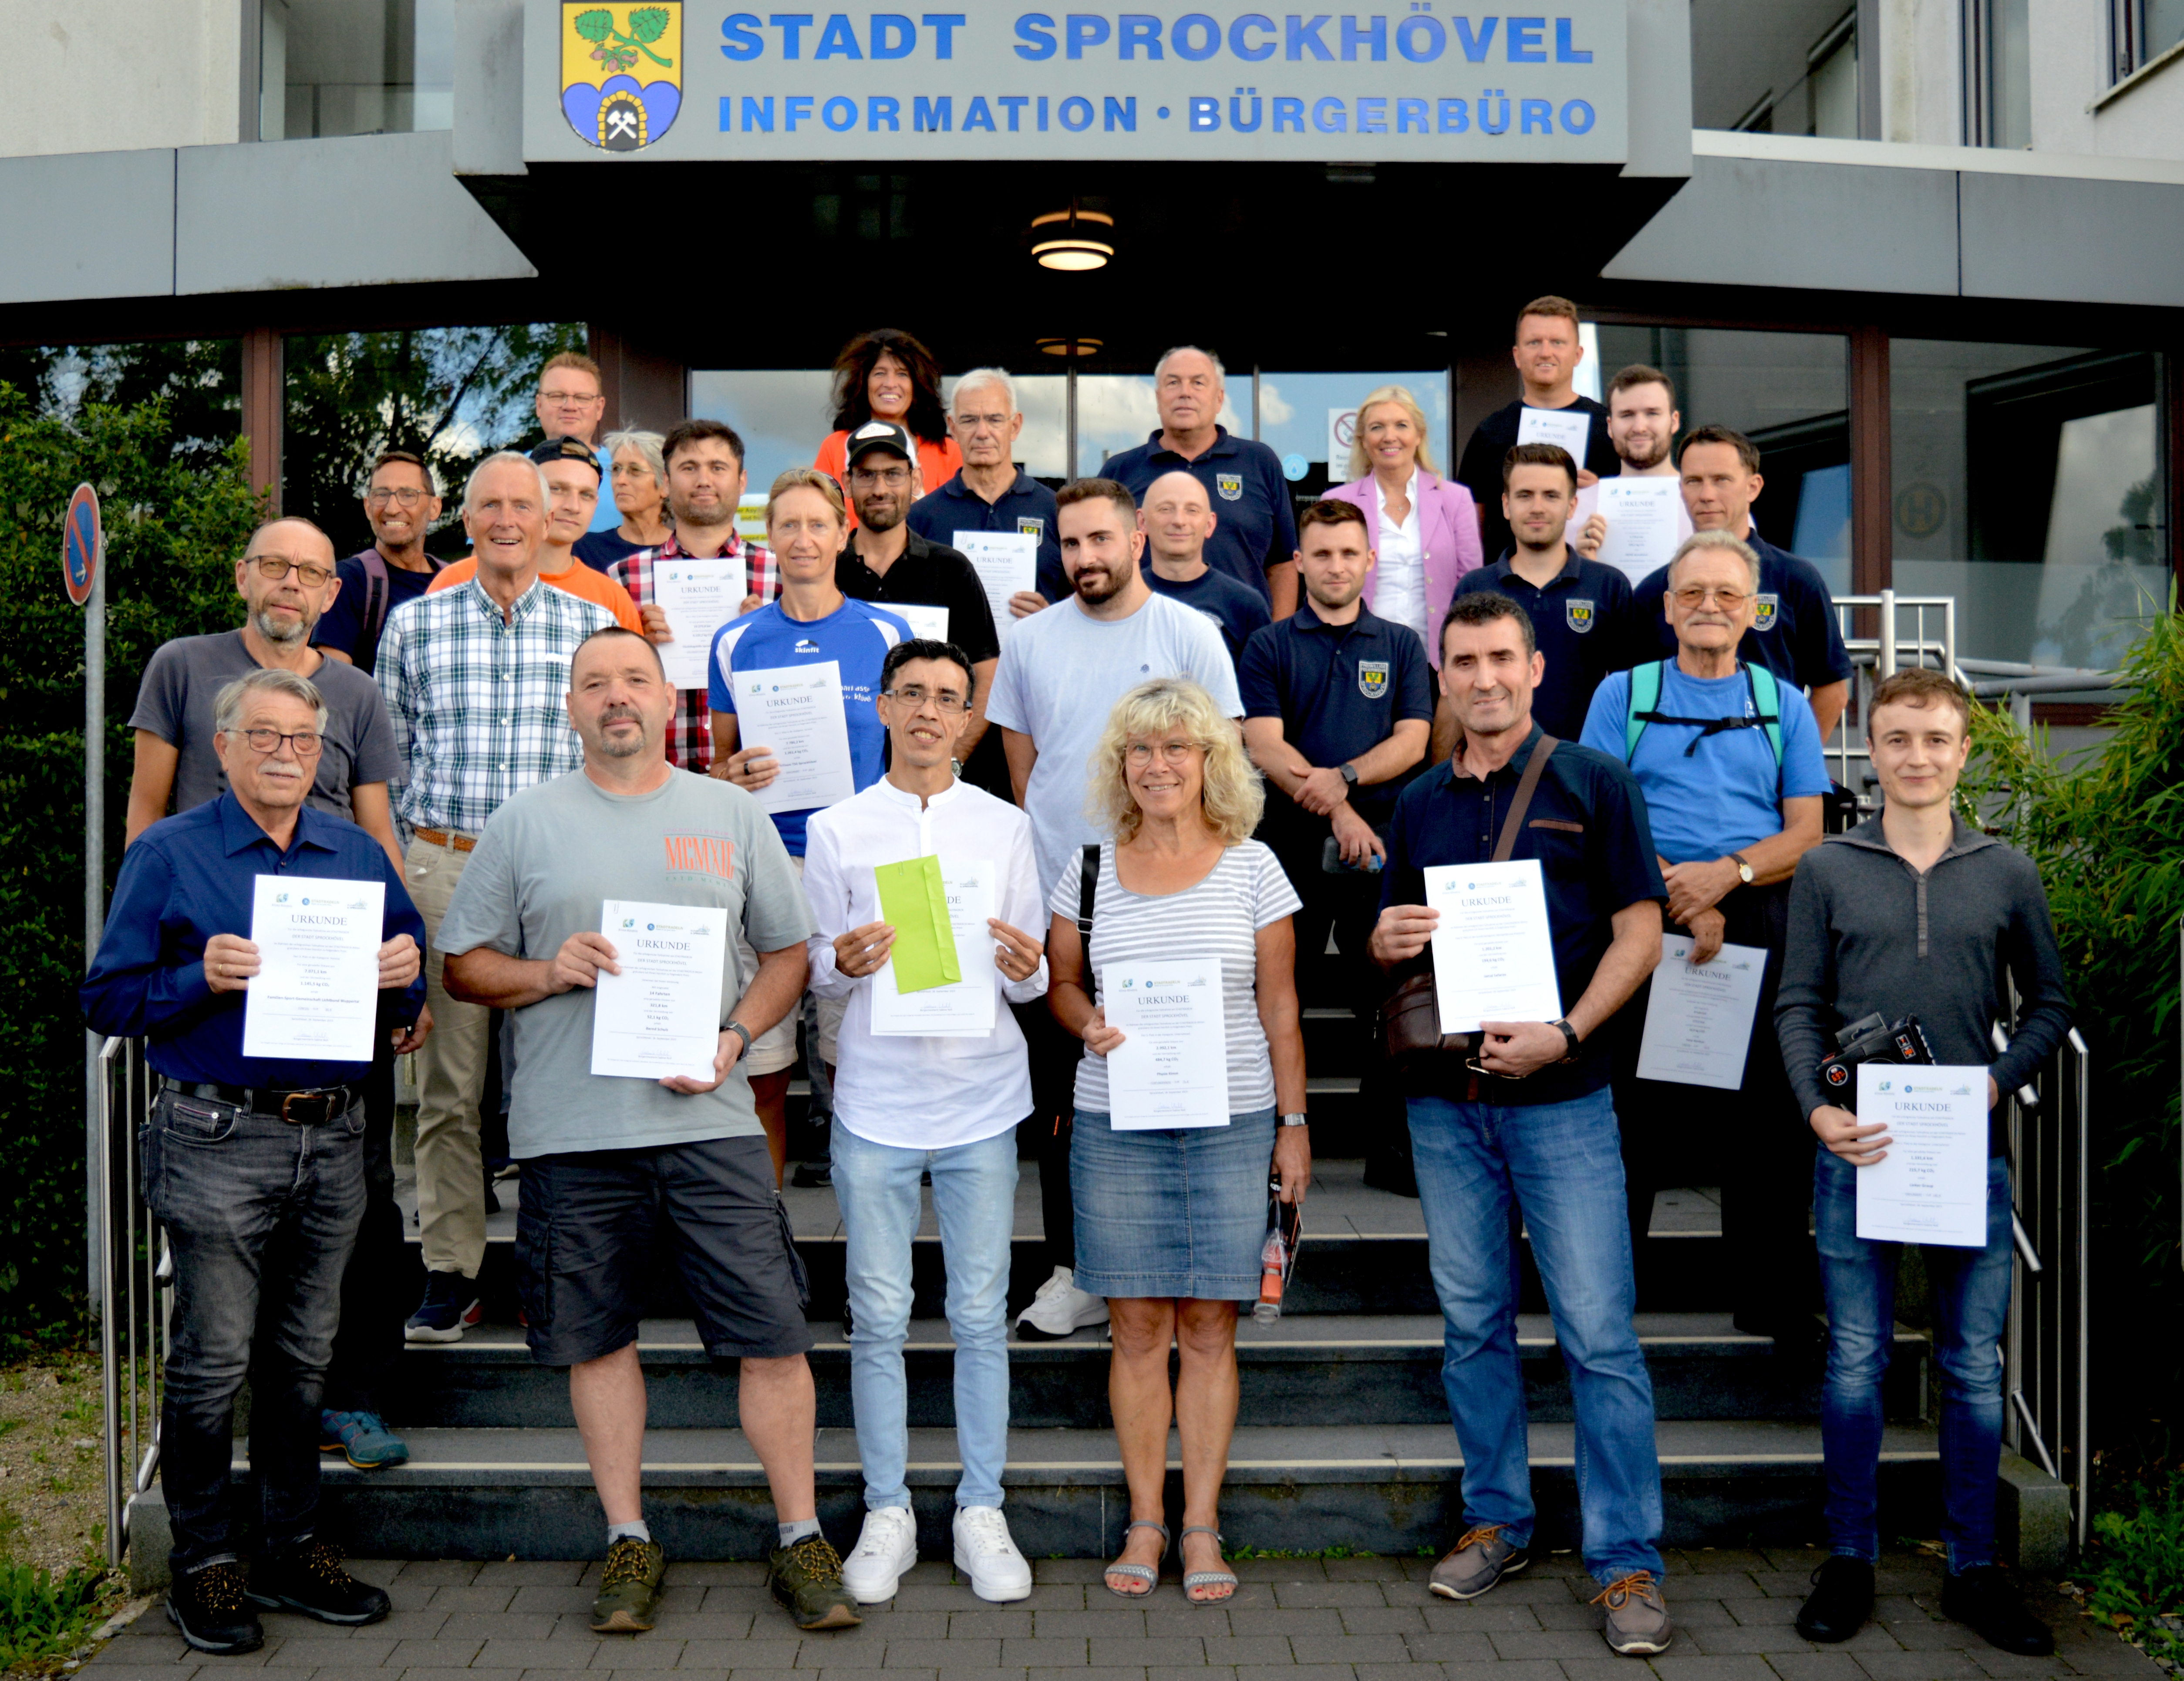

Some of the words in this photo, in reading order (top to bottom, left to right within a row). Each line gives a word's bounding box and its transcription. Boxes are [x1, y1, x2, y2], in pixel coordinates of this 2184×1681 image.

[720, 13, 966, 62] STADT
[1013, 2, 1593, 64] SPROCKHÖVEL
[719, 96, 1136, 133] INFORMATION
[1189, 88, 1595, 136] BÜRGERBÜRO
[766, 695, 812, 707] URKUNDE
[1461, 895, 1511, 907] URKUNDE
[292, 914, 347, 926] URKUNDE
[637, 939, 691, 951] URKUNDE
[1685, 967, 1731, 980] URKUNDE
[1138, 994, 1190, 1005] URKUNDE
[1895, 1102, 1951, 1112] URKUNDE
